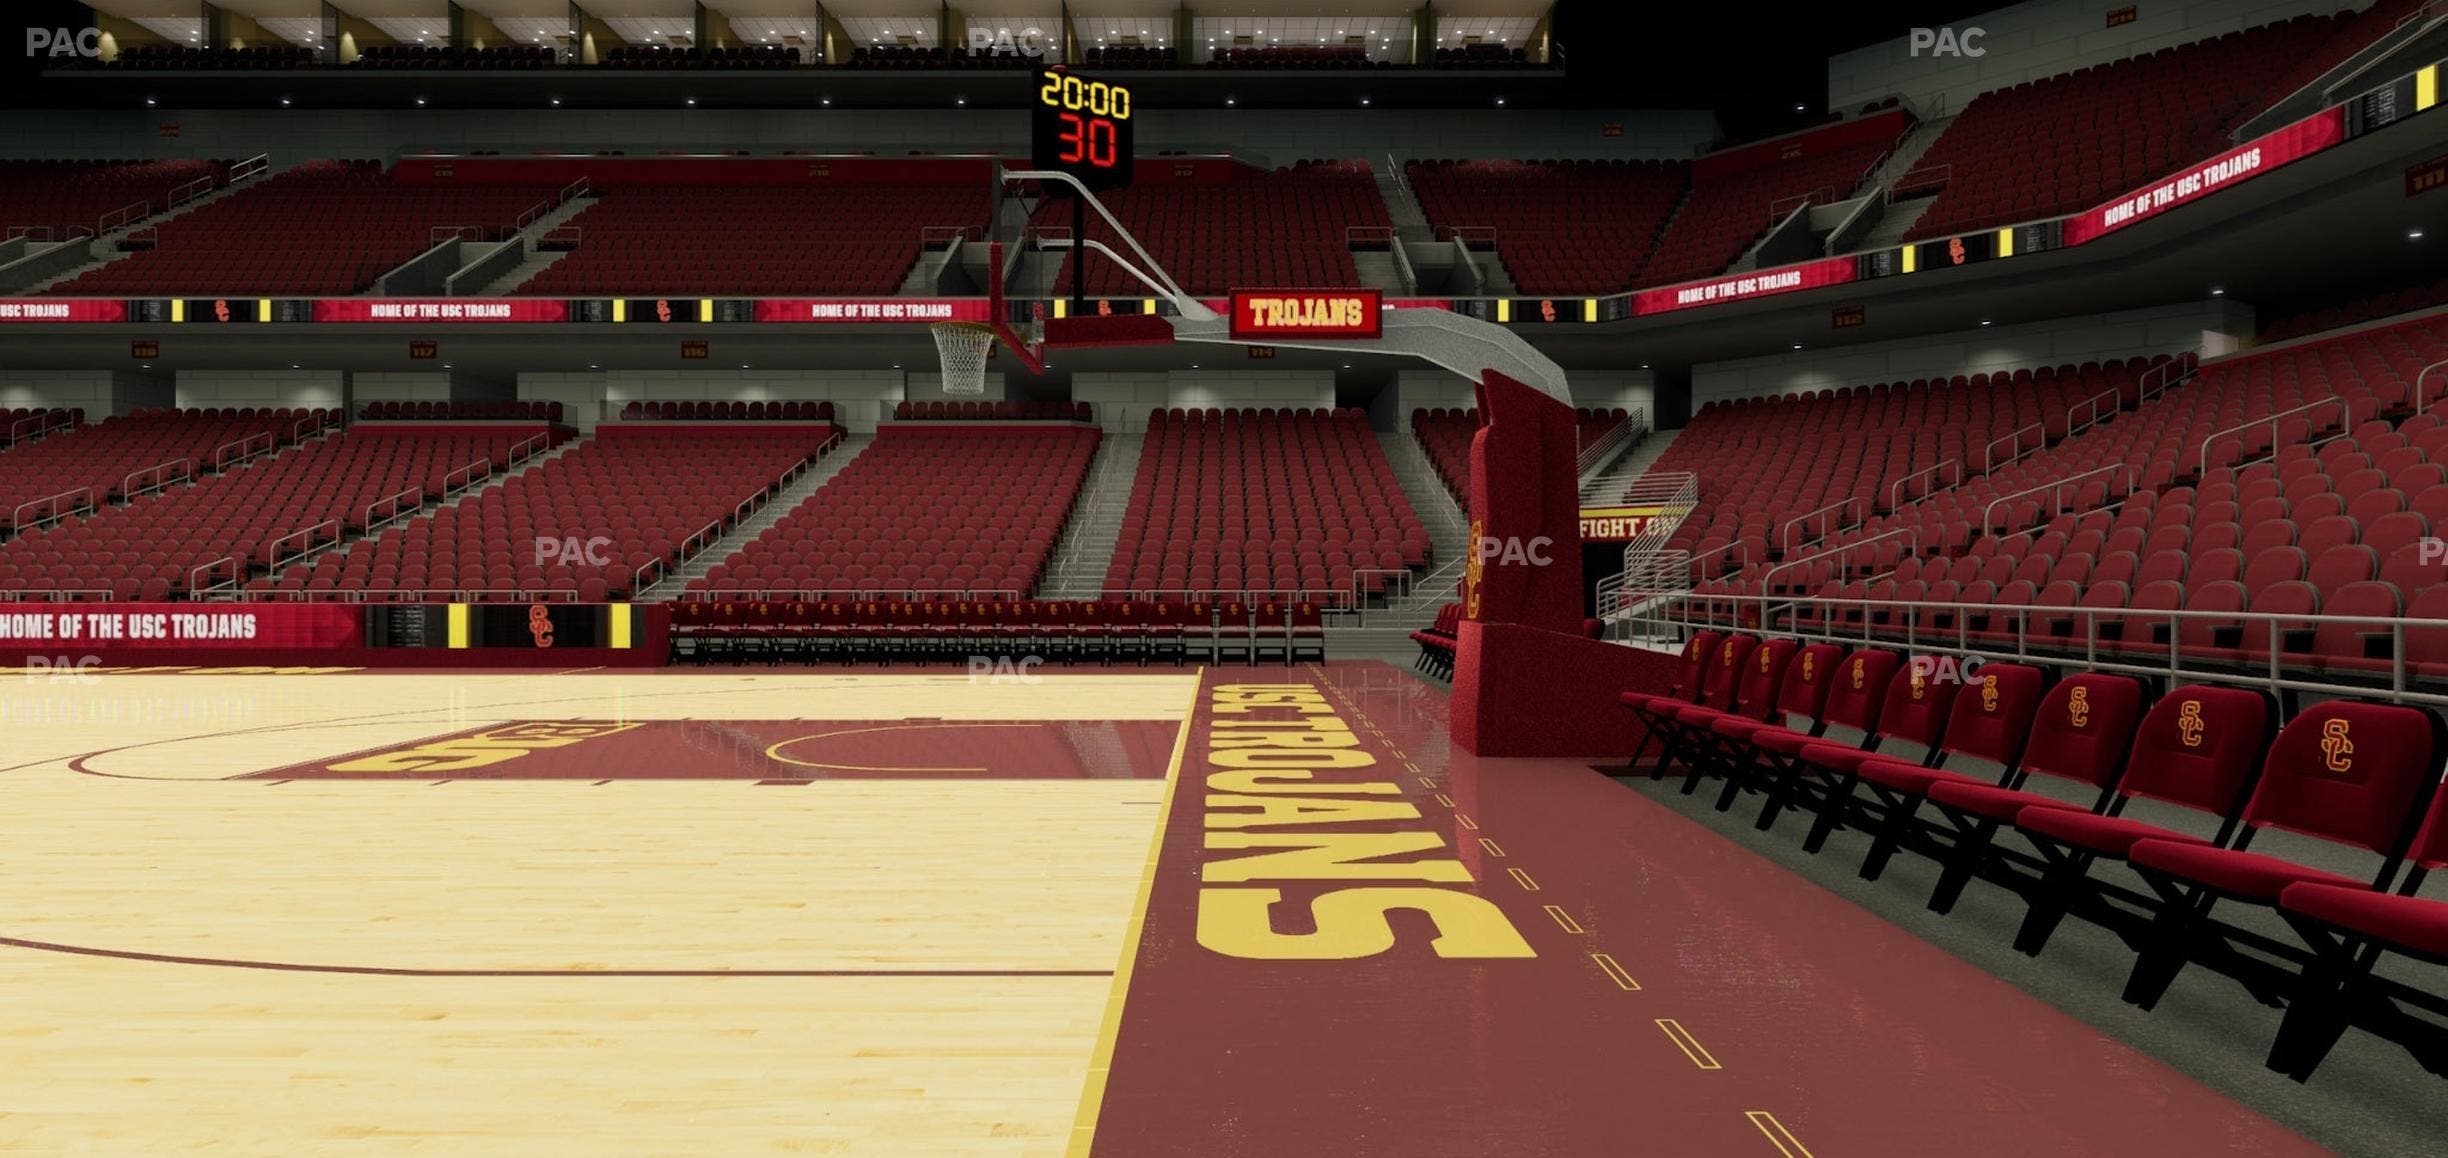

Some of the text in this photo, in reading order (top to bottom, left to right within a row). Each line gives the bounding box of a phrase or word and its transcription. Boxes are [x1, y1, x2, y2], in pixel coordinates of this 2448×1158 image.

[1041, 70, 1131, 120] 20:00
[1058, 111, 1118, 168] 30
[2104, 147, 2261, 227] HOME OF THE USC TROJANS
[1678, 271, 1801, 304] HOME OF THE USC TROJANS
[0, 304, 70, 318] USC TROJANS
[371, 304, 511, 318] HOME OF THE USC TROJANS
[812, 304, 952, 318] HOME OF THE USC TROJANS
[1249, 298, 1364, 327] TROJANS
[1580, 518, 1640, 539] FIGHT
[0, 613, 257, 638] HOME OF THE USC TROJANS
[2321, 718, 2354, 772] SC
[1196, 684, 1538, 959] USC TROJANS
